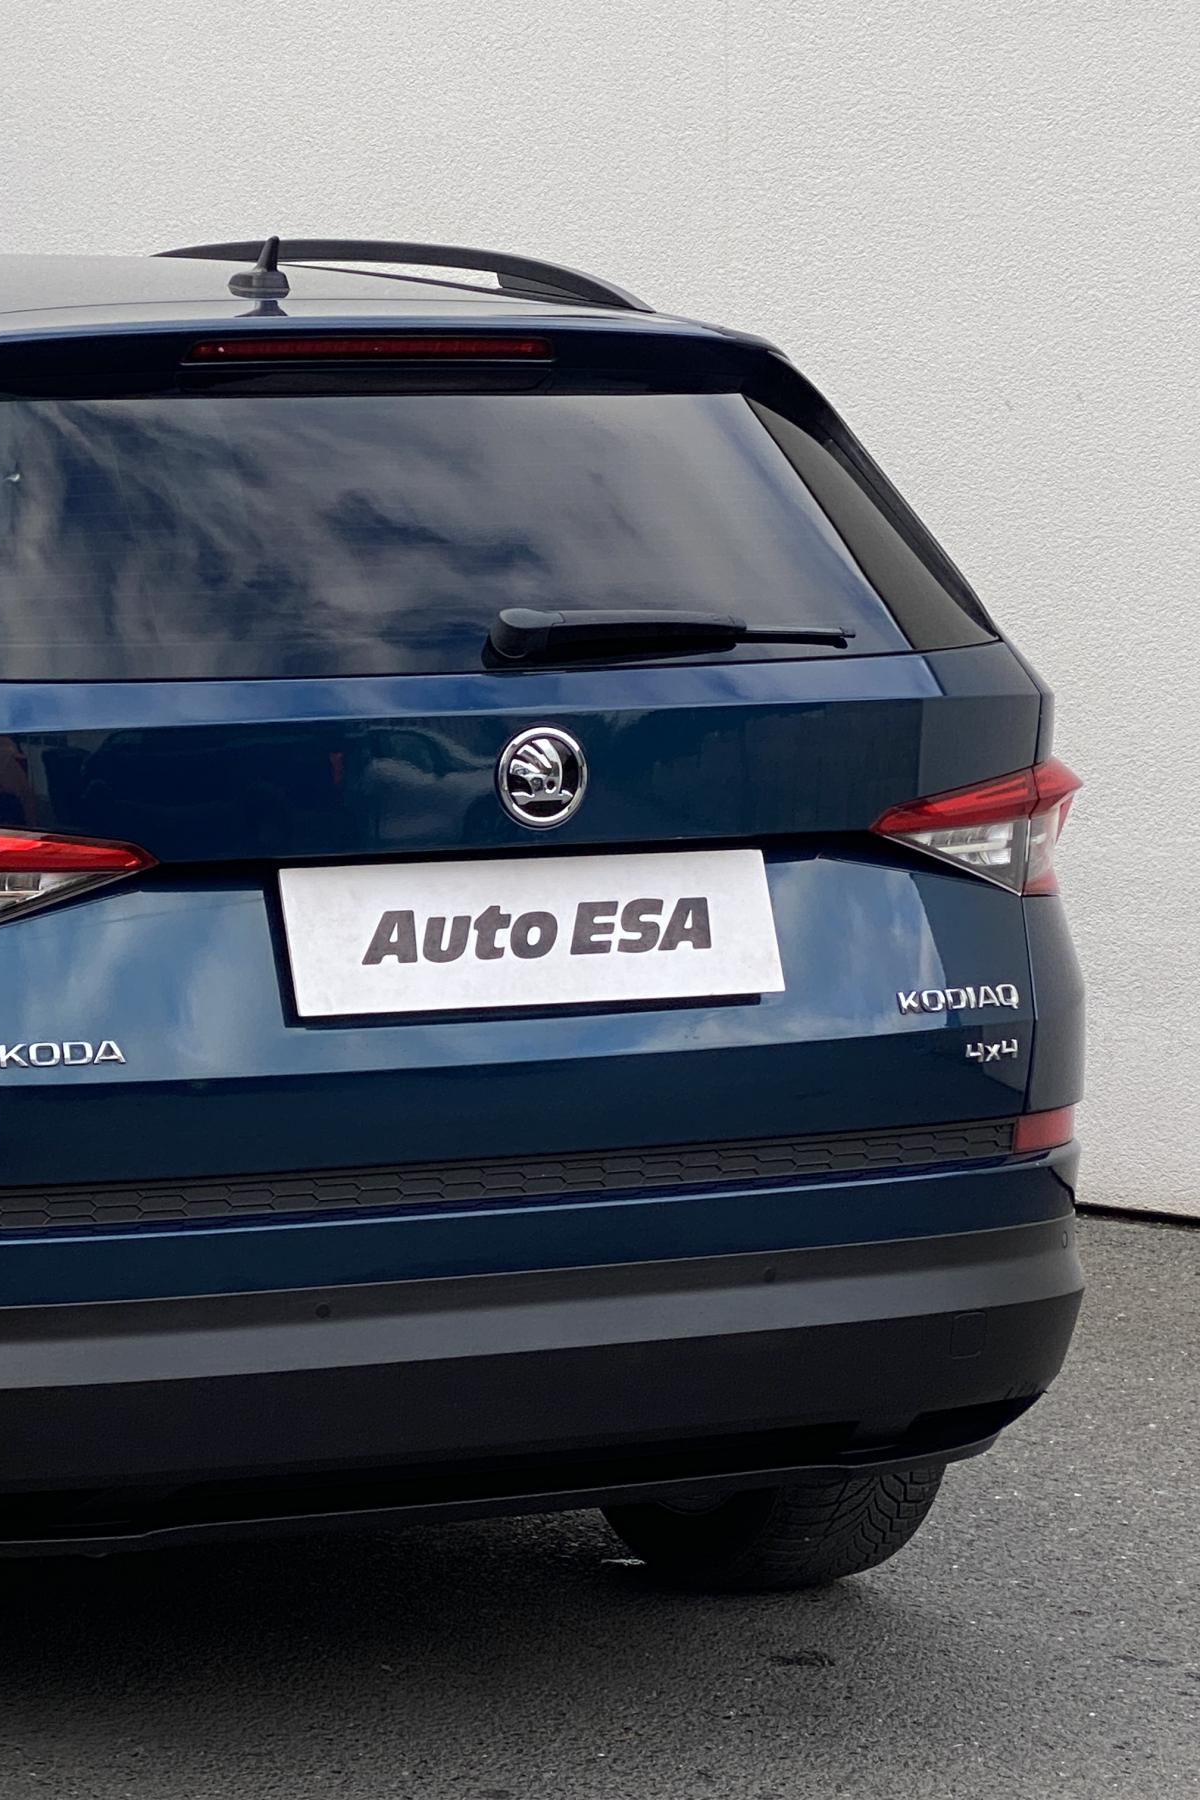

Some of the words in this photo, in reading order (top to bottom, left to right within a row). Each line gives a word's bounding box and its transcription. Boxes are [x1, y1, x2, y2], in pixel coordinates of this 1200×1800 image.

[361, 904, 558, 965] Auto
[569, 896, 712, 956] ESA
[897, 983, 1019, 1014] KODIAQ
[965, 1038, 1018, 1063] 4x4
